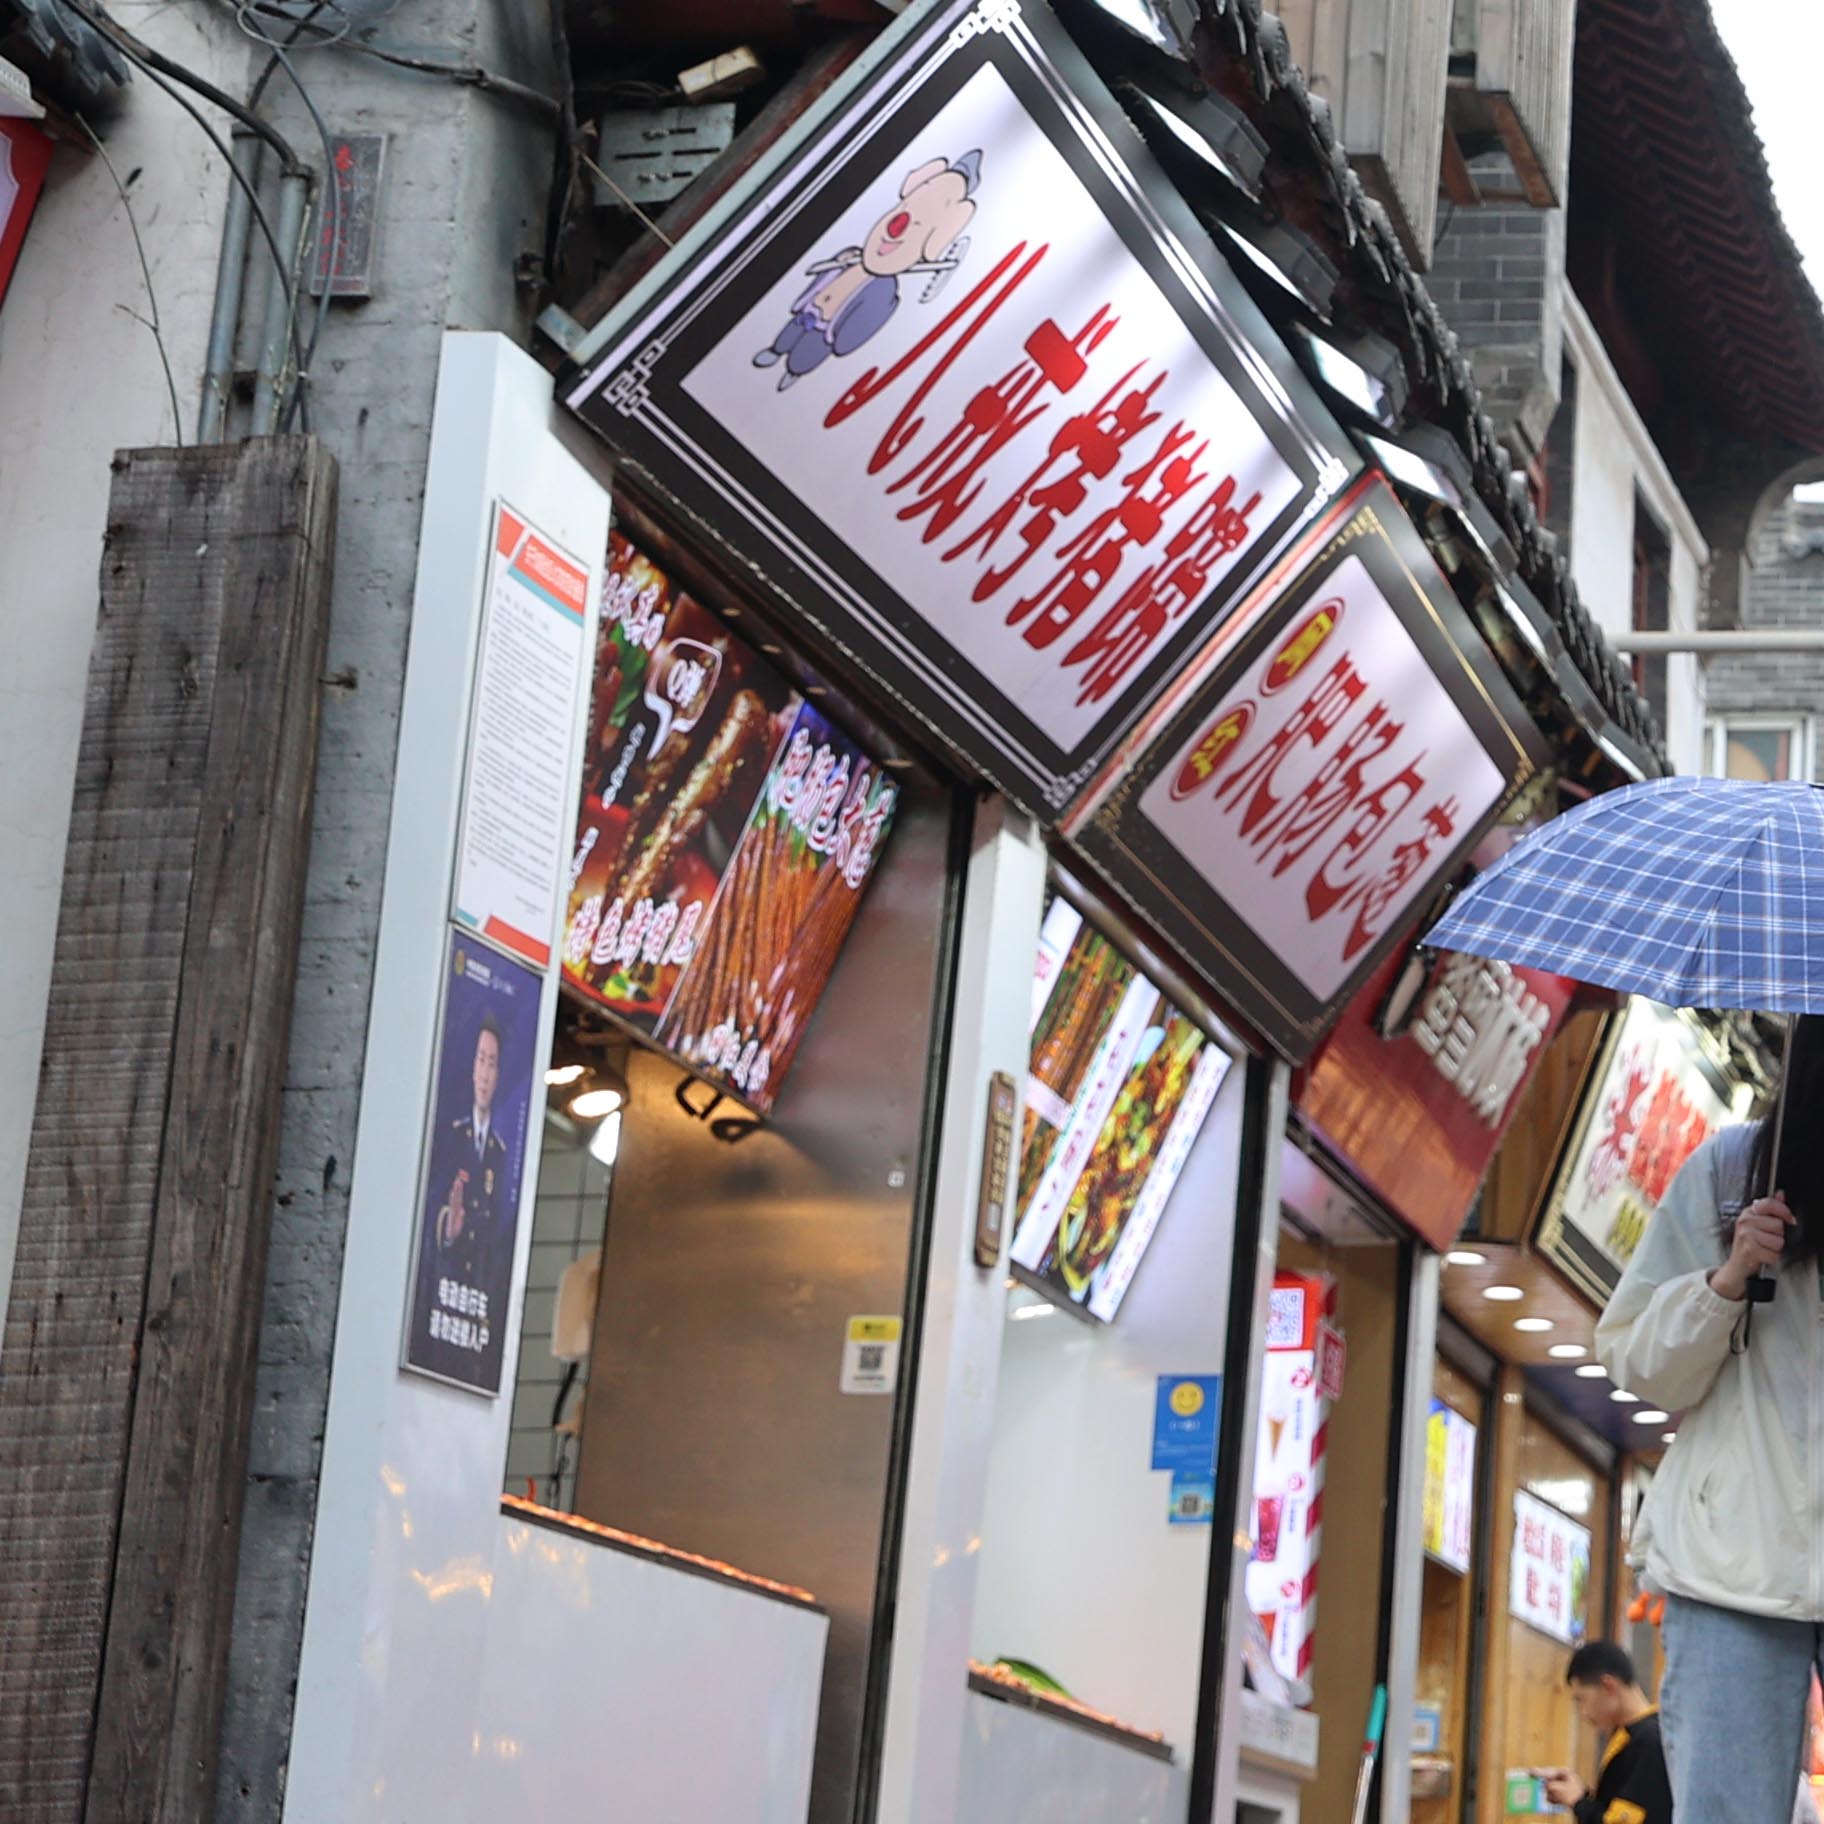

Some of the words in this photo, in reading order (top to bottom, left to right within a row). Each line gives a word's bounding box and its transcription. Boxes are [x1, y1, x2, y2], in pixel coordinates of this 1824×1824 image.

[822, 239, 1264, 707] 八戒烤猪蹄
[1216, 649, 1460, 961] 肥肠包葱
